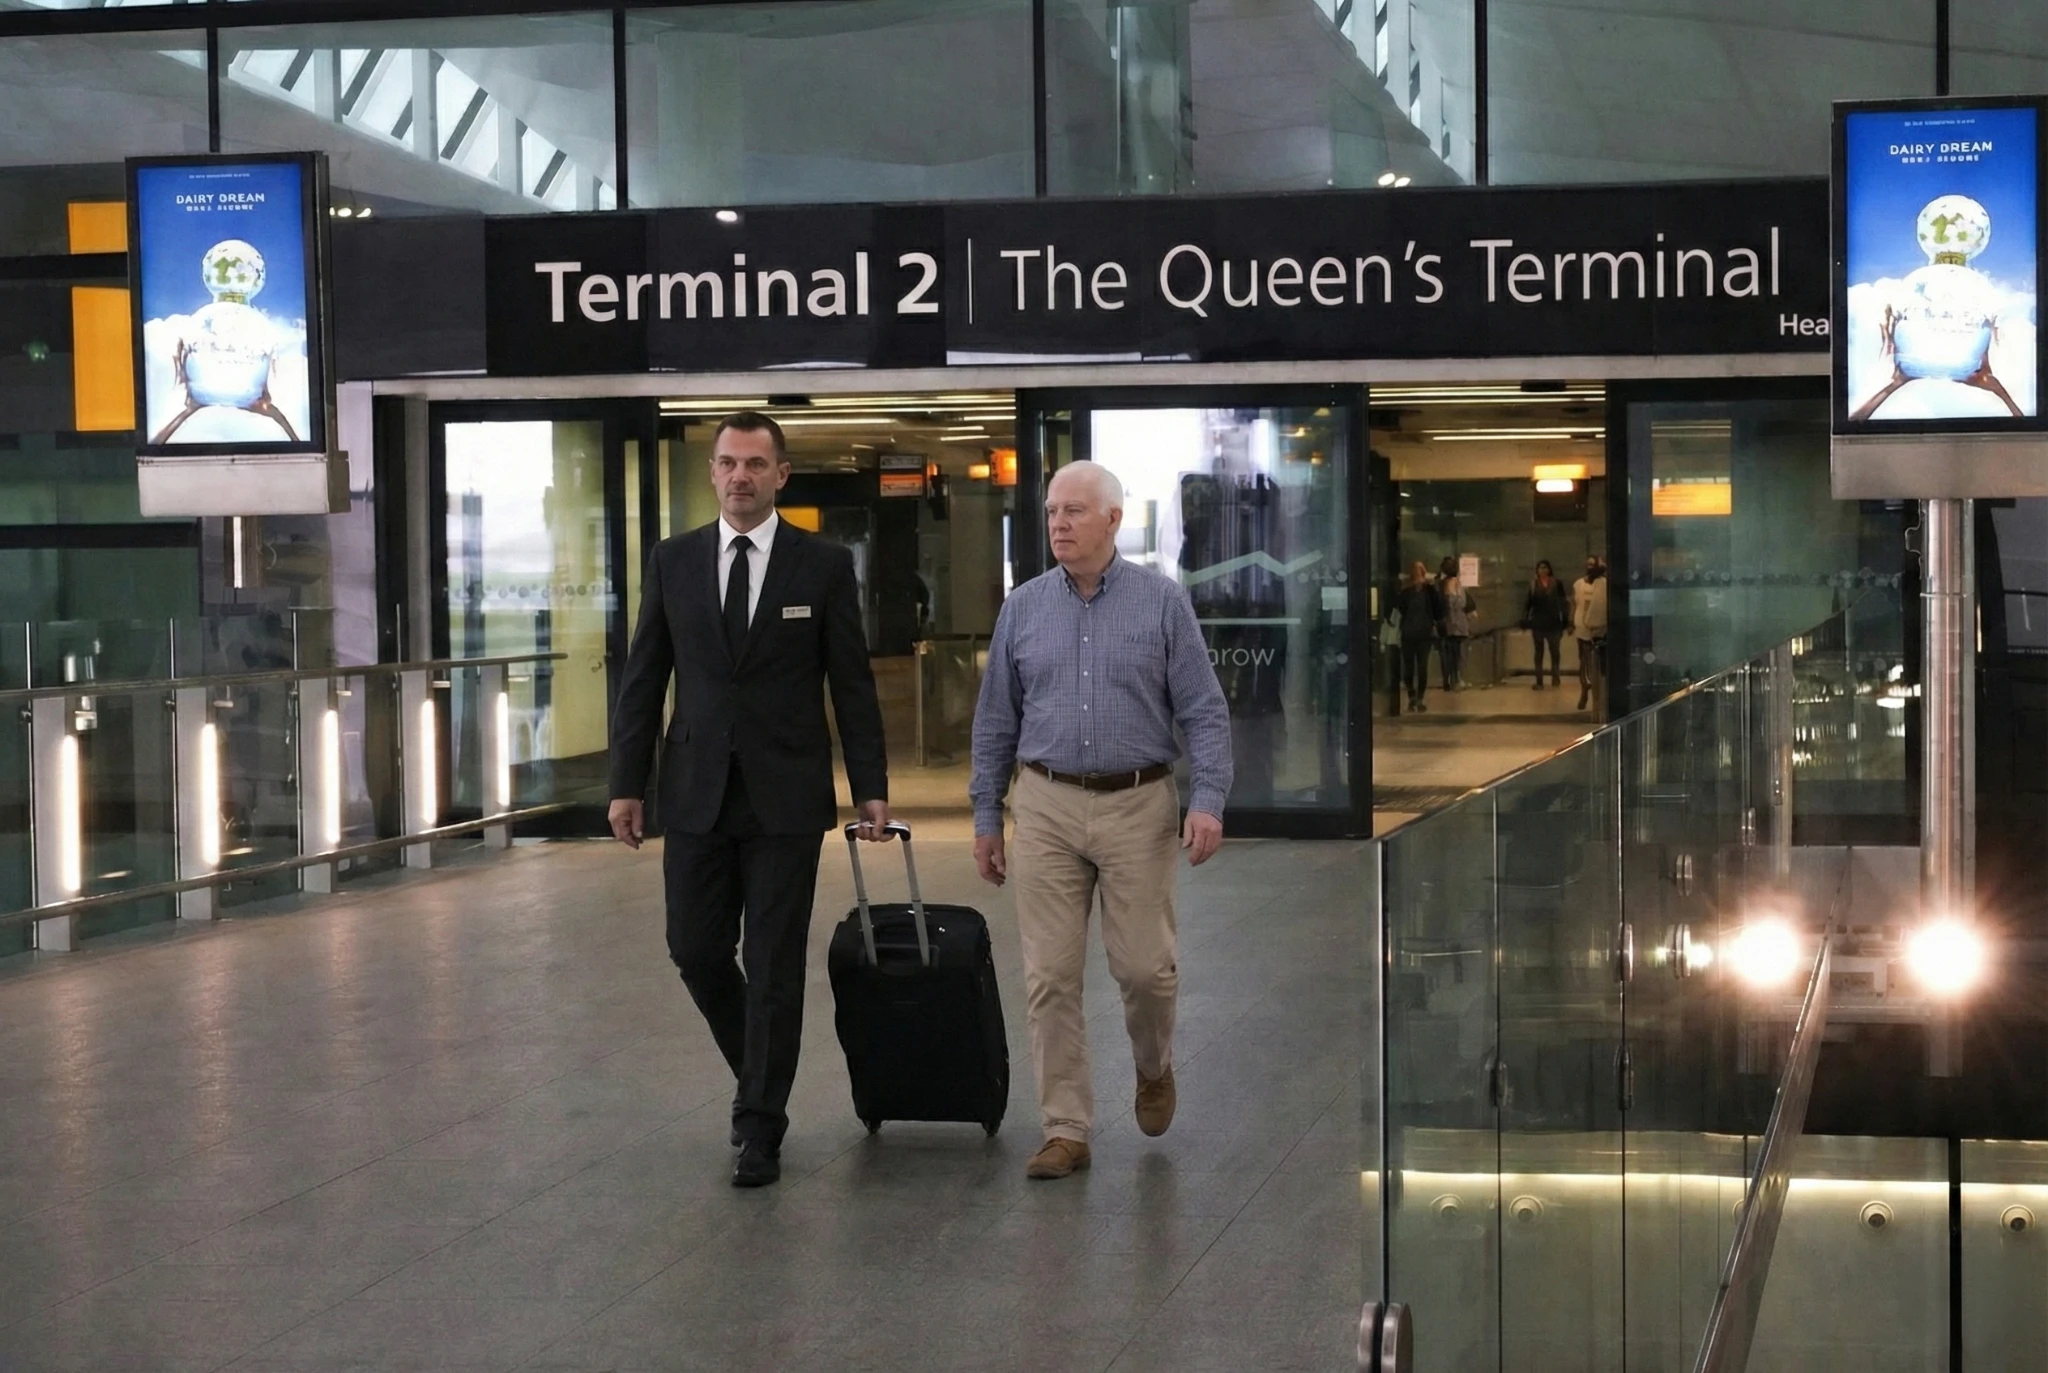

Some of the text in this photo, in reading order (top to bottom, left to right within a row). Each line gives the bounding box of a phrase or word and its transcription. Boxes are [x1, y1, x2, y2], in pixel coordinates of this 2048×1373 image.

[1890, 141, 1992, 155] DAIRY DREAM
[176, 194, 214, 204] DAIRY
[534, 251, 869, 323] Terminal
[897, 252, 939, 315] 2
[1000, 244, 1128, 311] The
[1469, 226, 1780, 303] Terminal
